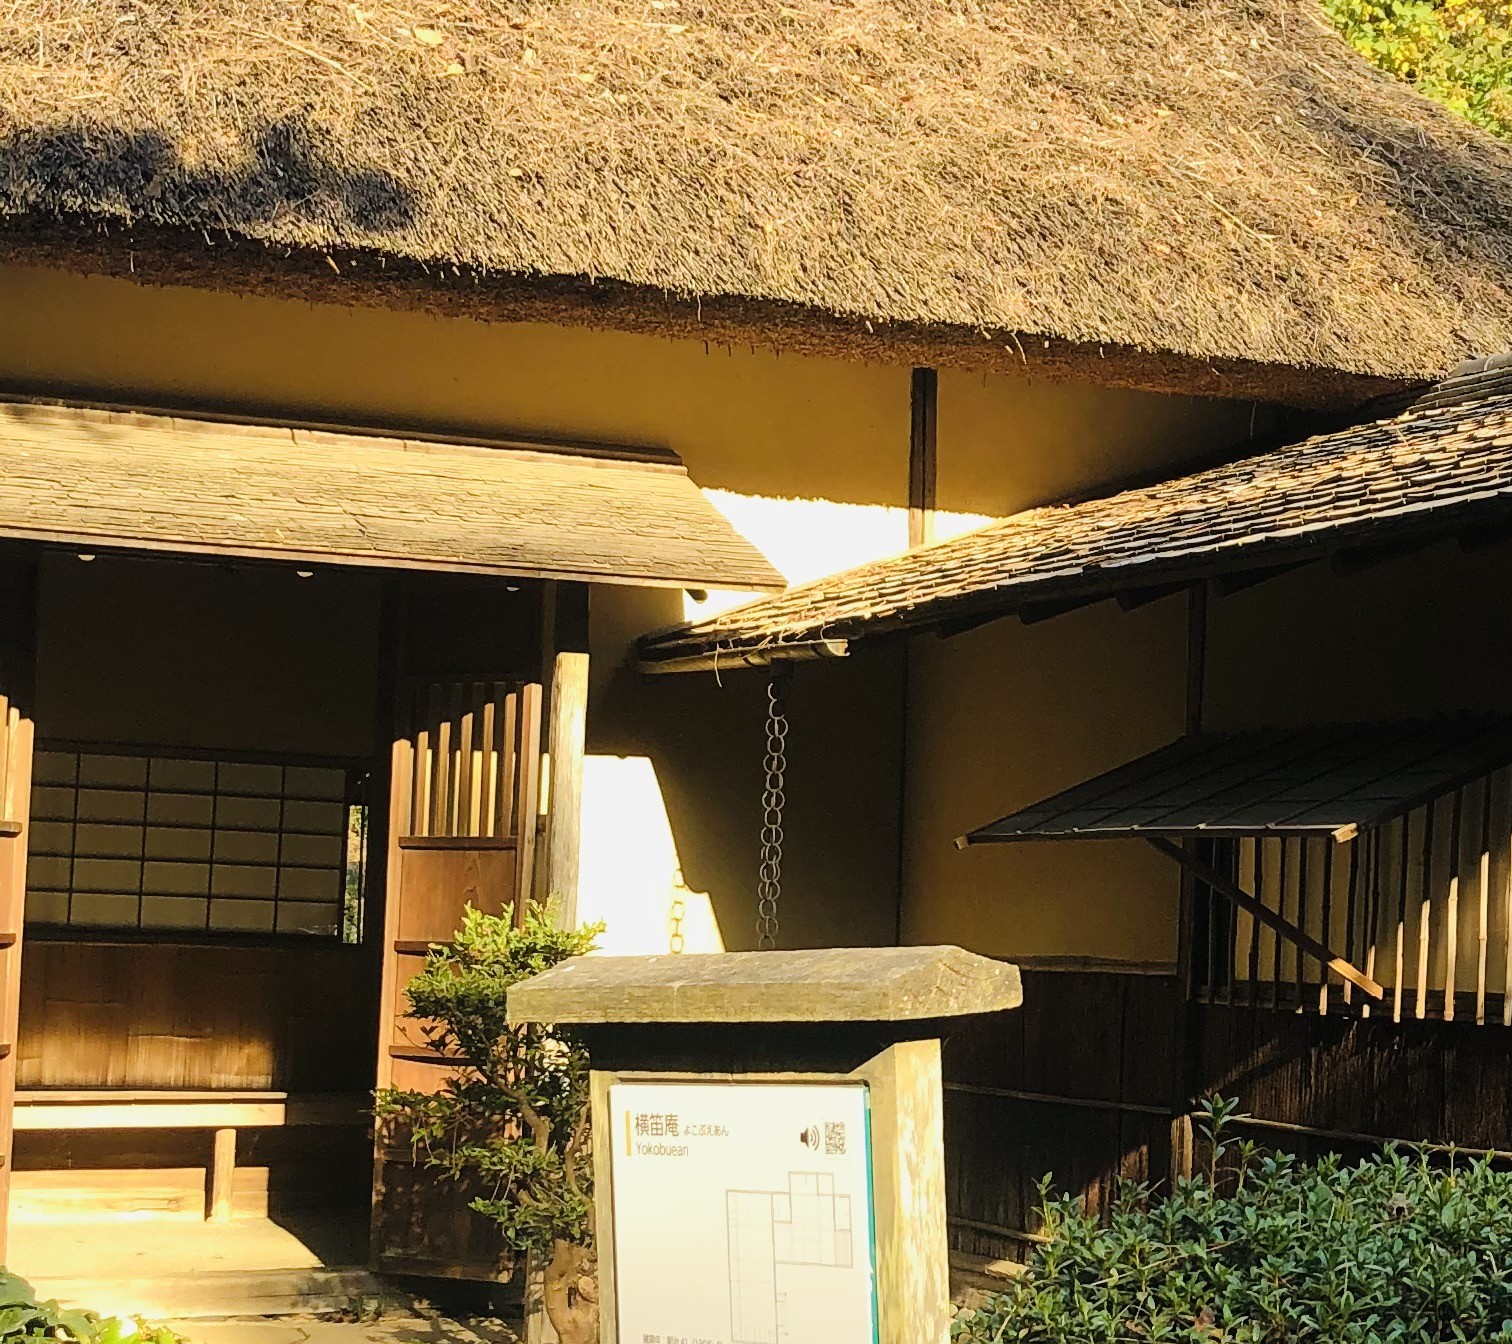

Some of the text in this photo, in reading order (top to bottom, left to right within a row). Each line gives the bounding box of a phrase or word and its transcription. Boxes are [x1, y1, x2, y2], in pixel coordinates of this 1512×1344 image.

[633, 1111, 730, 1137] 横笛庵 よこぶえあん
[634, 1140, 689, 1157] Yokobuean
